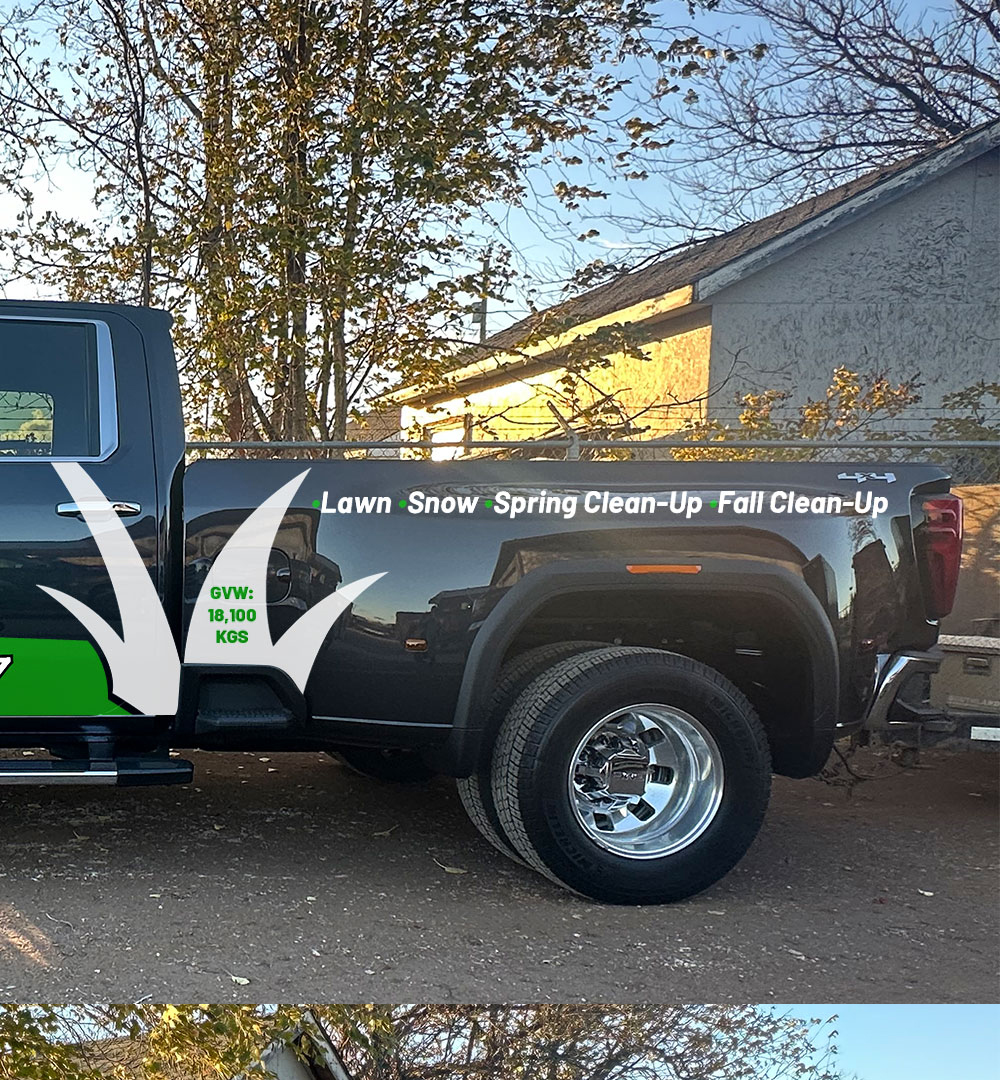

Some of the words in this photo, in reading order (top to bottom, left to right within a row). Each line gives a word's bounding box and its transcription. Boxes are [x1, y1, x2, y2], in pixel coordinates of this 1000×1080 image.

[320, 490, 391, 514] Lawn
[407, 490, 479, 514] Snow
[493, 490, 577, 519] Spring
[584, 490, 702, 518] Clean-Up
[717, 490, 764, 514] Fall
[769, 490, 889, 518] Clean-Up
[210, 586, 254, 600] GVW:
[207, 608, 257, 624] 18,100
[215, 629, 249, 644] KGS
